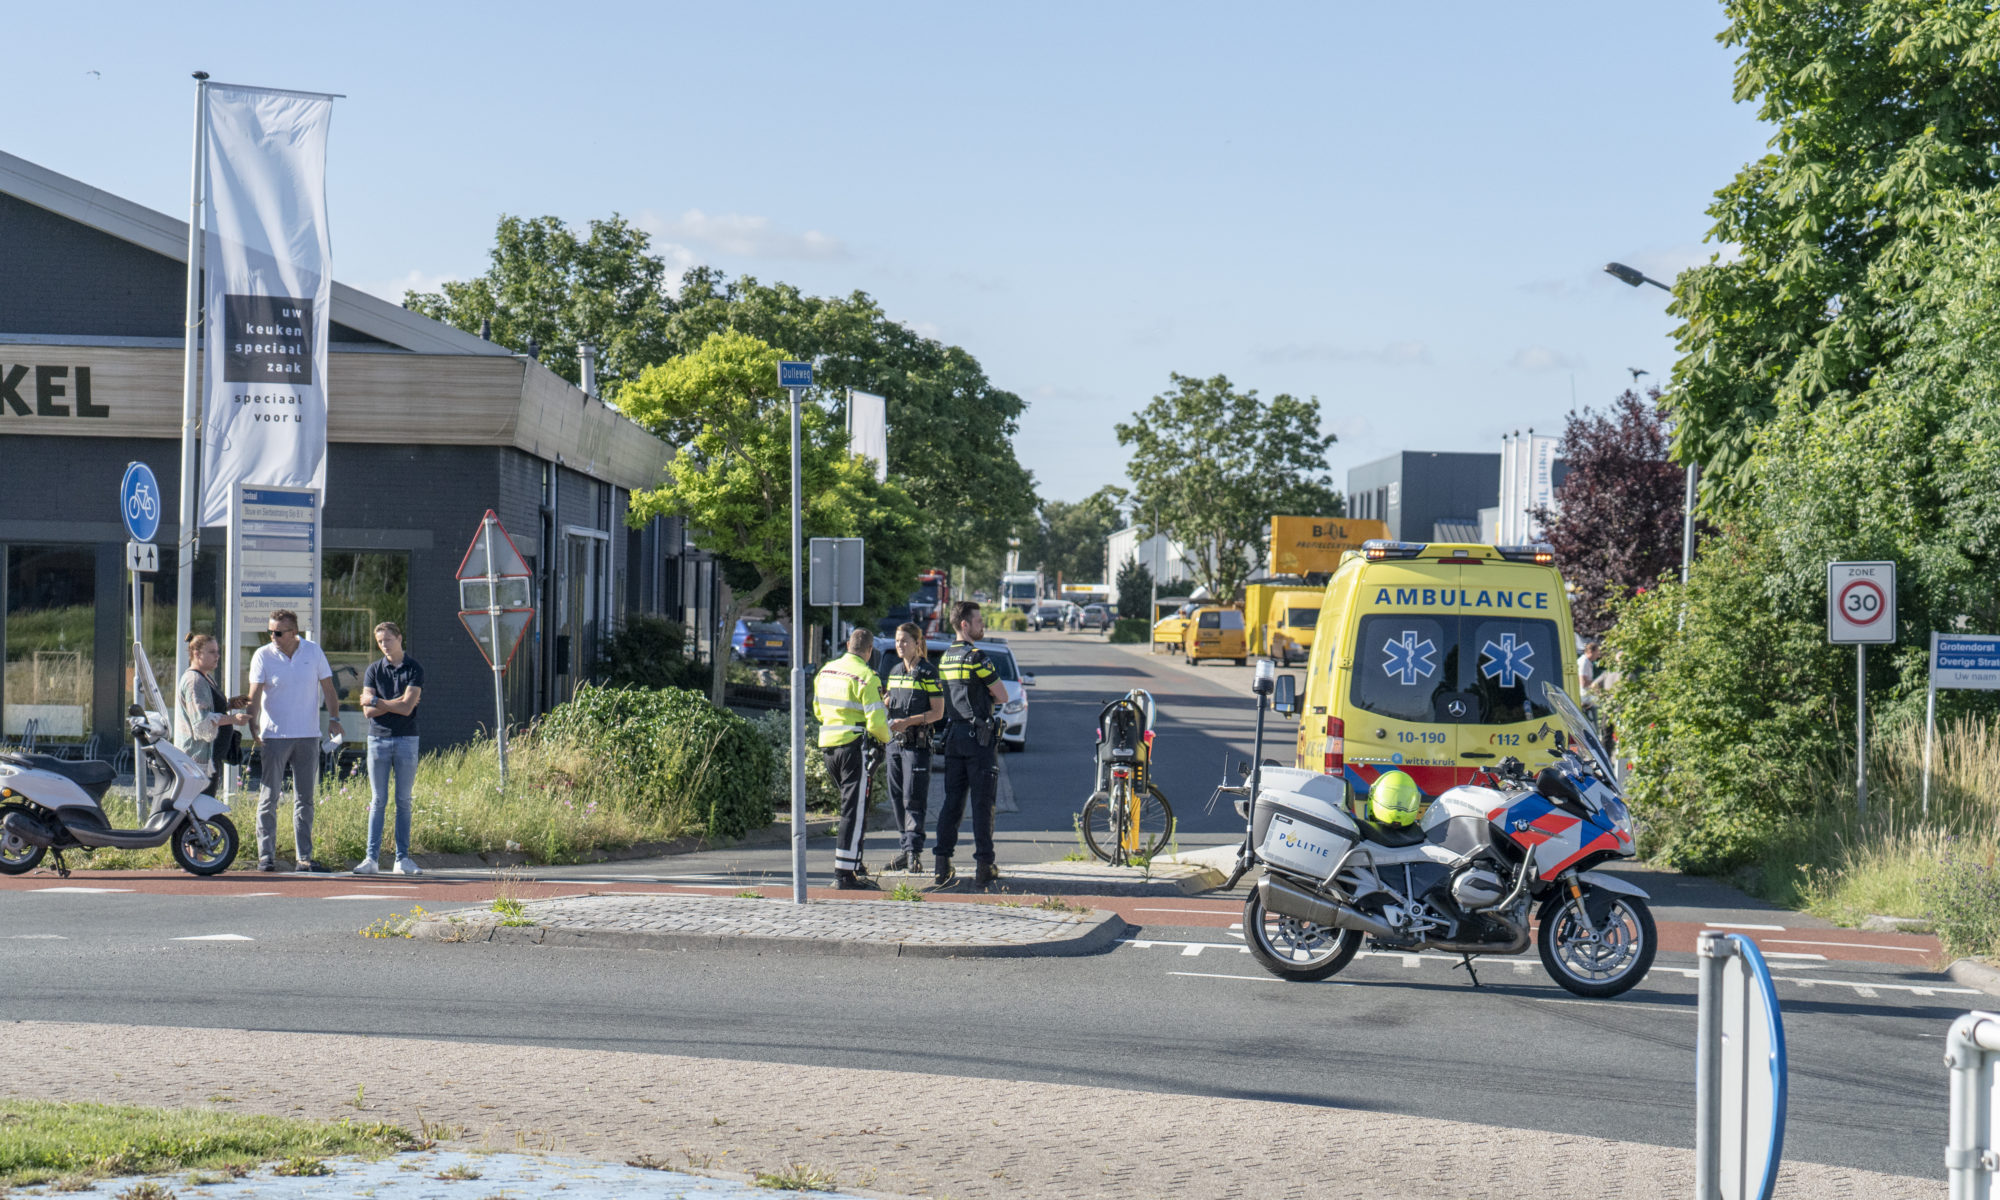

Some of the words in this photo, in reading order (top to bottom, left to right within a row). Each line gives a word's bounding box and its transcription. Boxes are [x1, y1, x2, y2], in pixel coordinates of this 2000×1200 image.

[282, 308, 302, 318] uw
[246, 323, 302, 336] keuken
[235, 343, 302, 355] speciaal
[266, 362, 302, 373] zaak
[783, 367, 811, 382] Dulleweg
[0, 364, 110, 418] KEL
[234, 393, 303, 405] speciaal
[254, 413, 289, 423] voor
[294, 414, 302, 423] u
[1849, 568, 1875, 576] ZONE
[1374, 588, 1548, 610] AMBULANCE
[1848, 594, 1877, 611] 30
[1940, 642, 1996, 652] Grotendorst
[1939, 656, 1976, 668] Overige
[1954, 672, 1970, 680] Uw
[1971, 673, 1998, 681] naam
[1397, 731, 1447, 744] 10-190
[1405, 757, 1430, 766] witte
[1432, 757, 1456, 767] kruis
[1279, 832, 1329, 858] POLITIE
